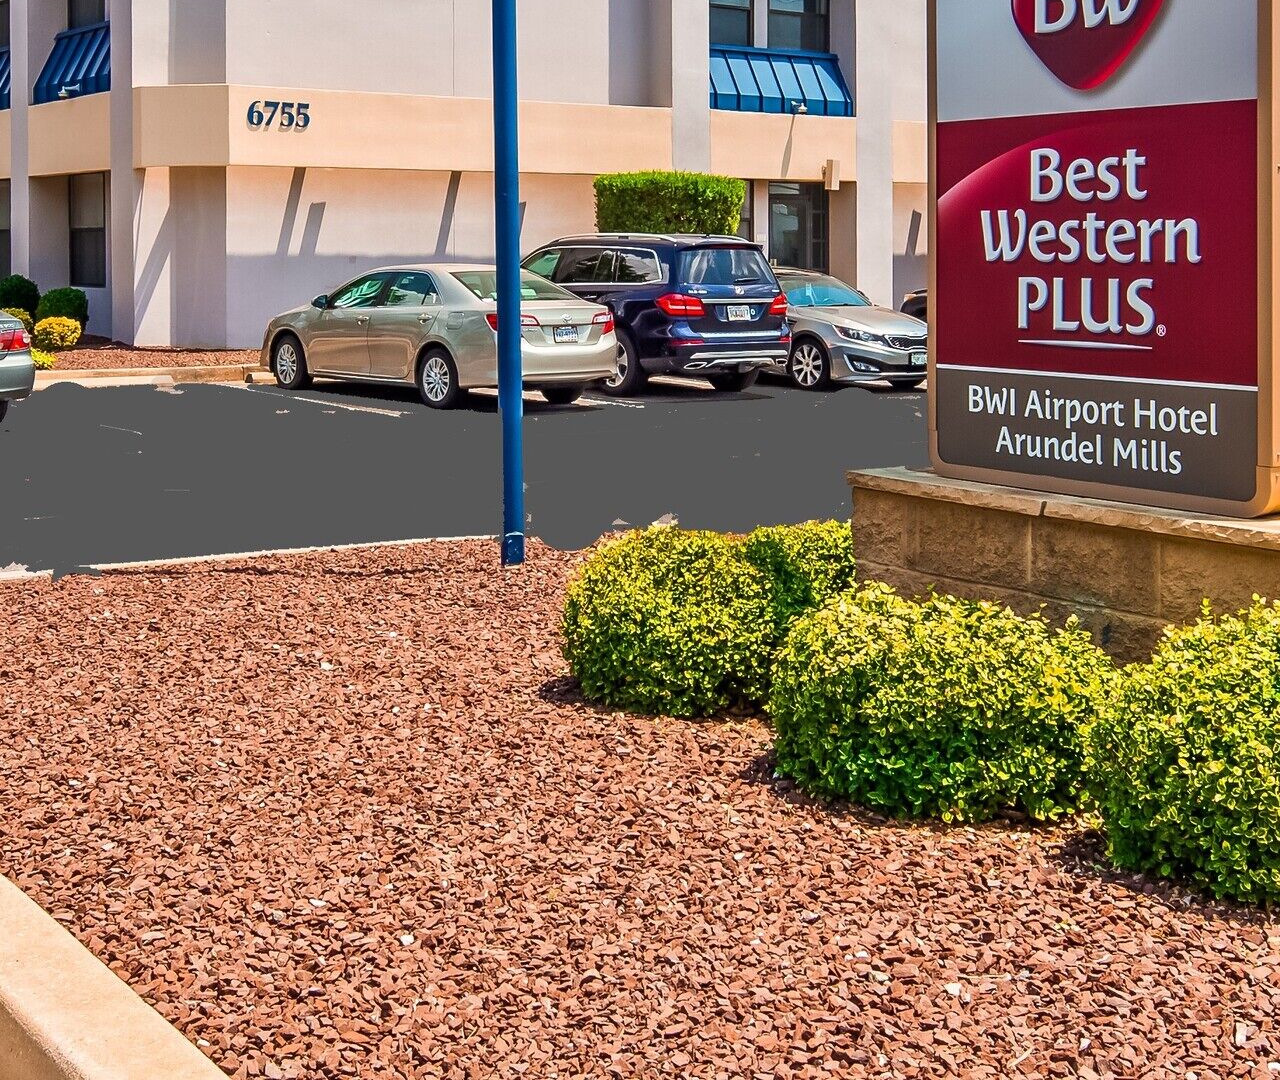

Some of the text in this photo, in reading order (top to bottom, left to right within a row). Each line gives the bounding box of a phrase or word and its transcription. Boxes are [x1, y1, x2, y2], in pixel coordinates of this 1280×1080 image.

[246, 99, 311, 129] 6755
[1029, 147, 1149, 203] Best
[980, 207, 1203, 265] Western
[967, 384, 1218, 437] BWI Airport Hotel
[995, 425, 1183, 475] Arundel Mills
